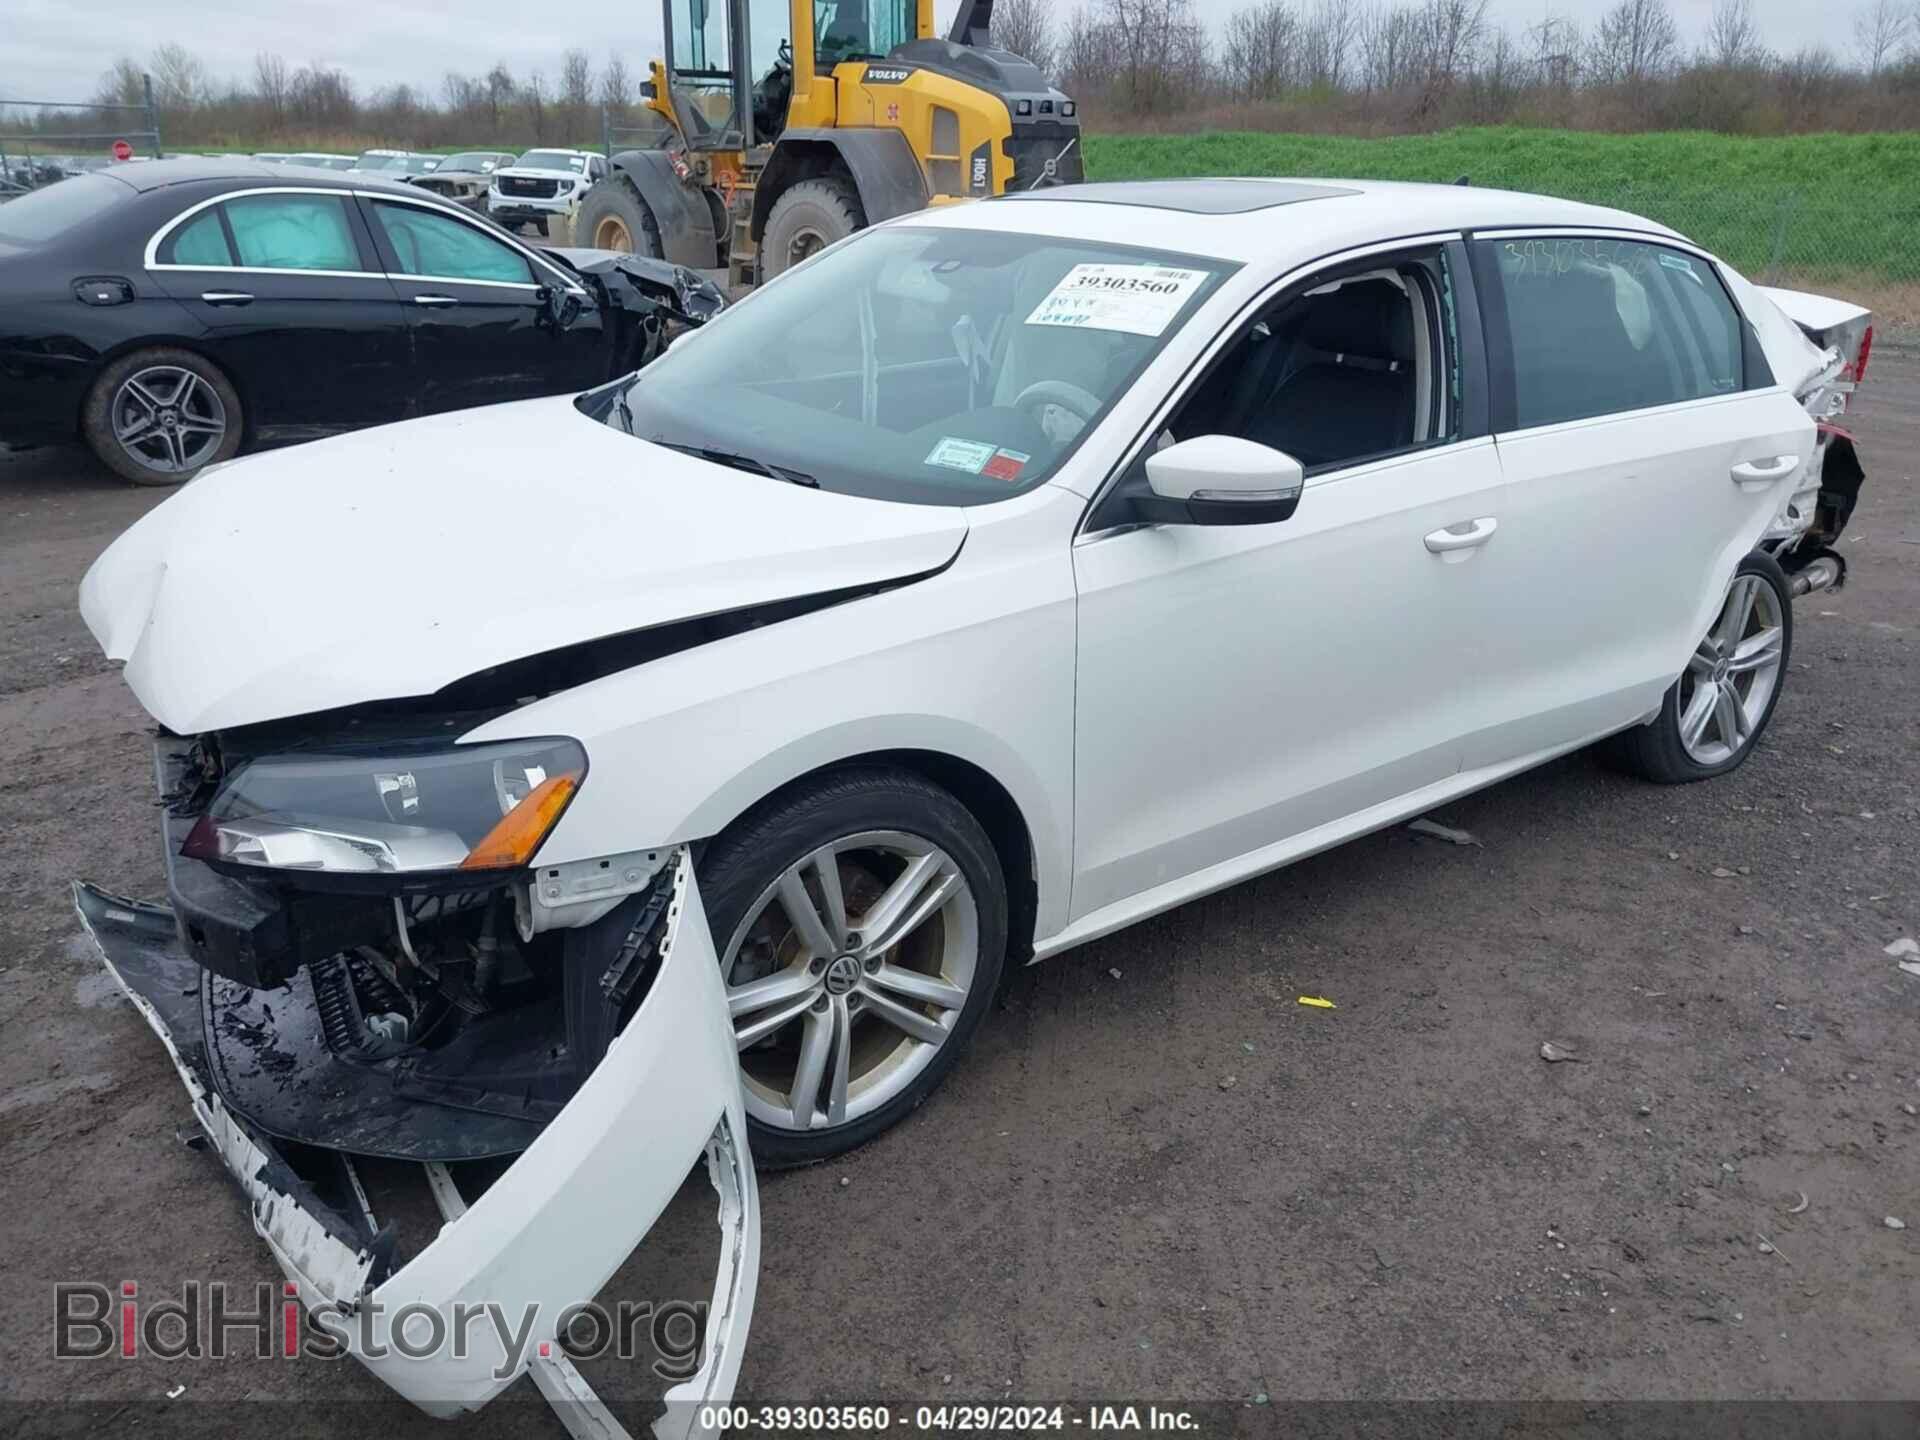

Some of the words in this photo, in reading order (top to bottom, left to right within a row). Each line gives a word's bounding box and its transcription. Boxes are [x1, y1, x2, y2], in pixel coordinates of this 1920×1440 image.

[867, 69, 908, 81] VOLVO
[973, 157, 987, 188] L90H
[1072, 276, 1180, 295] 39303560
